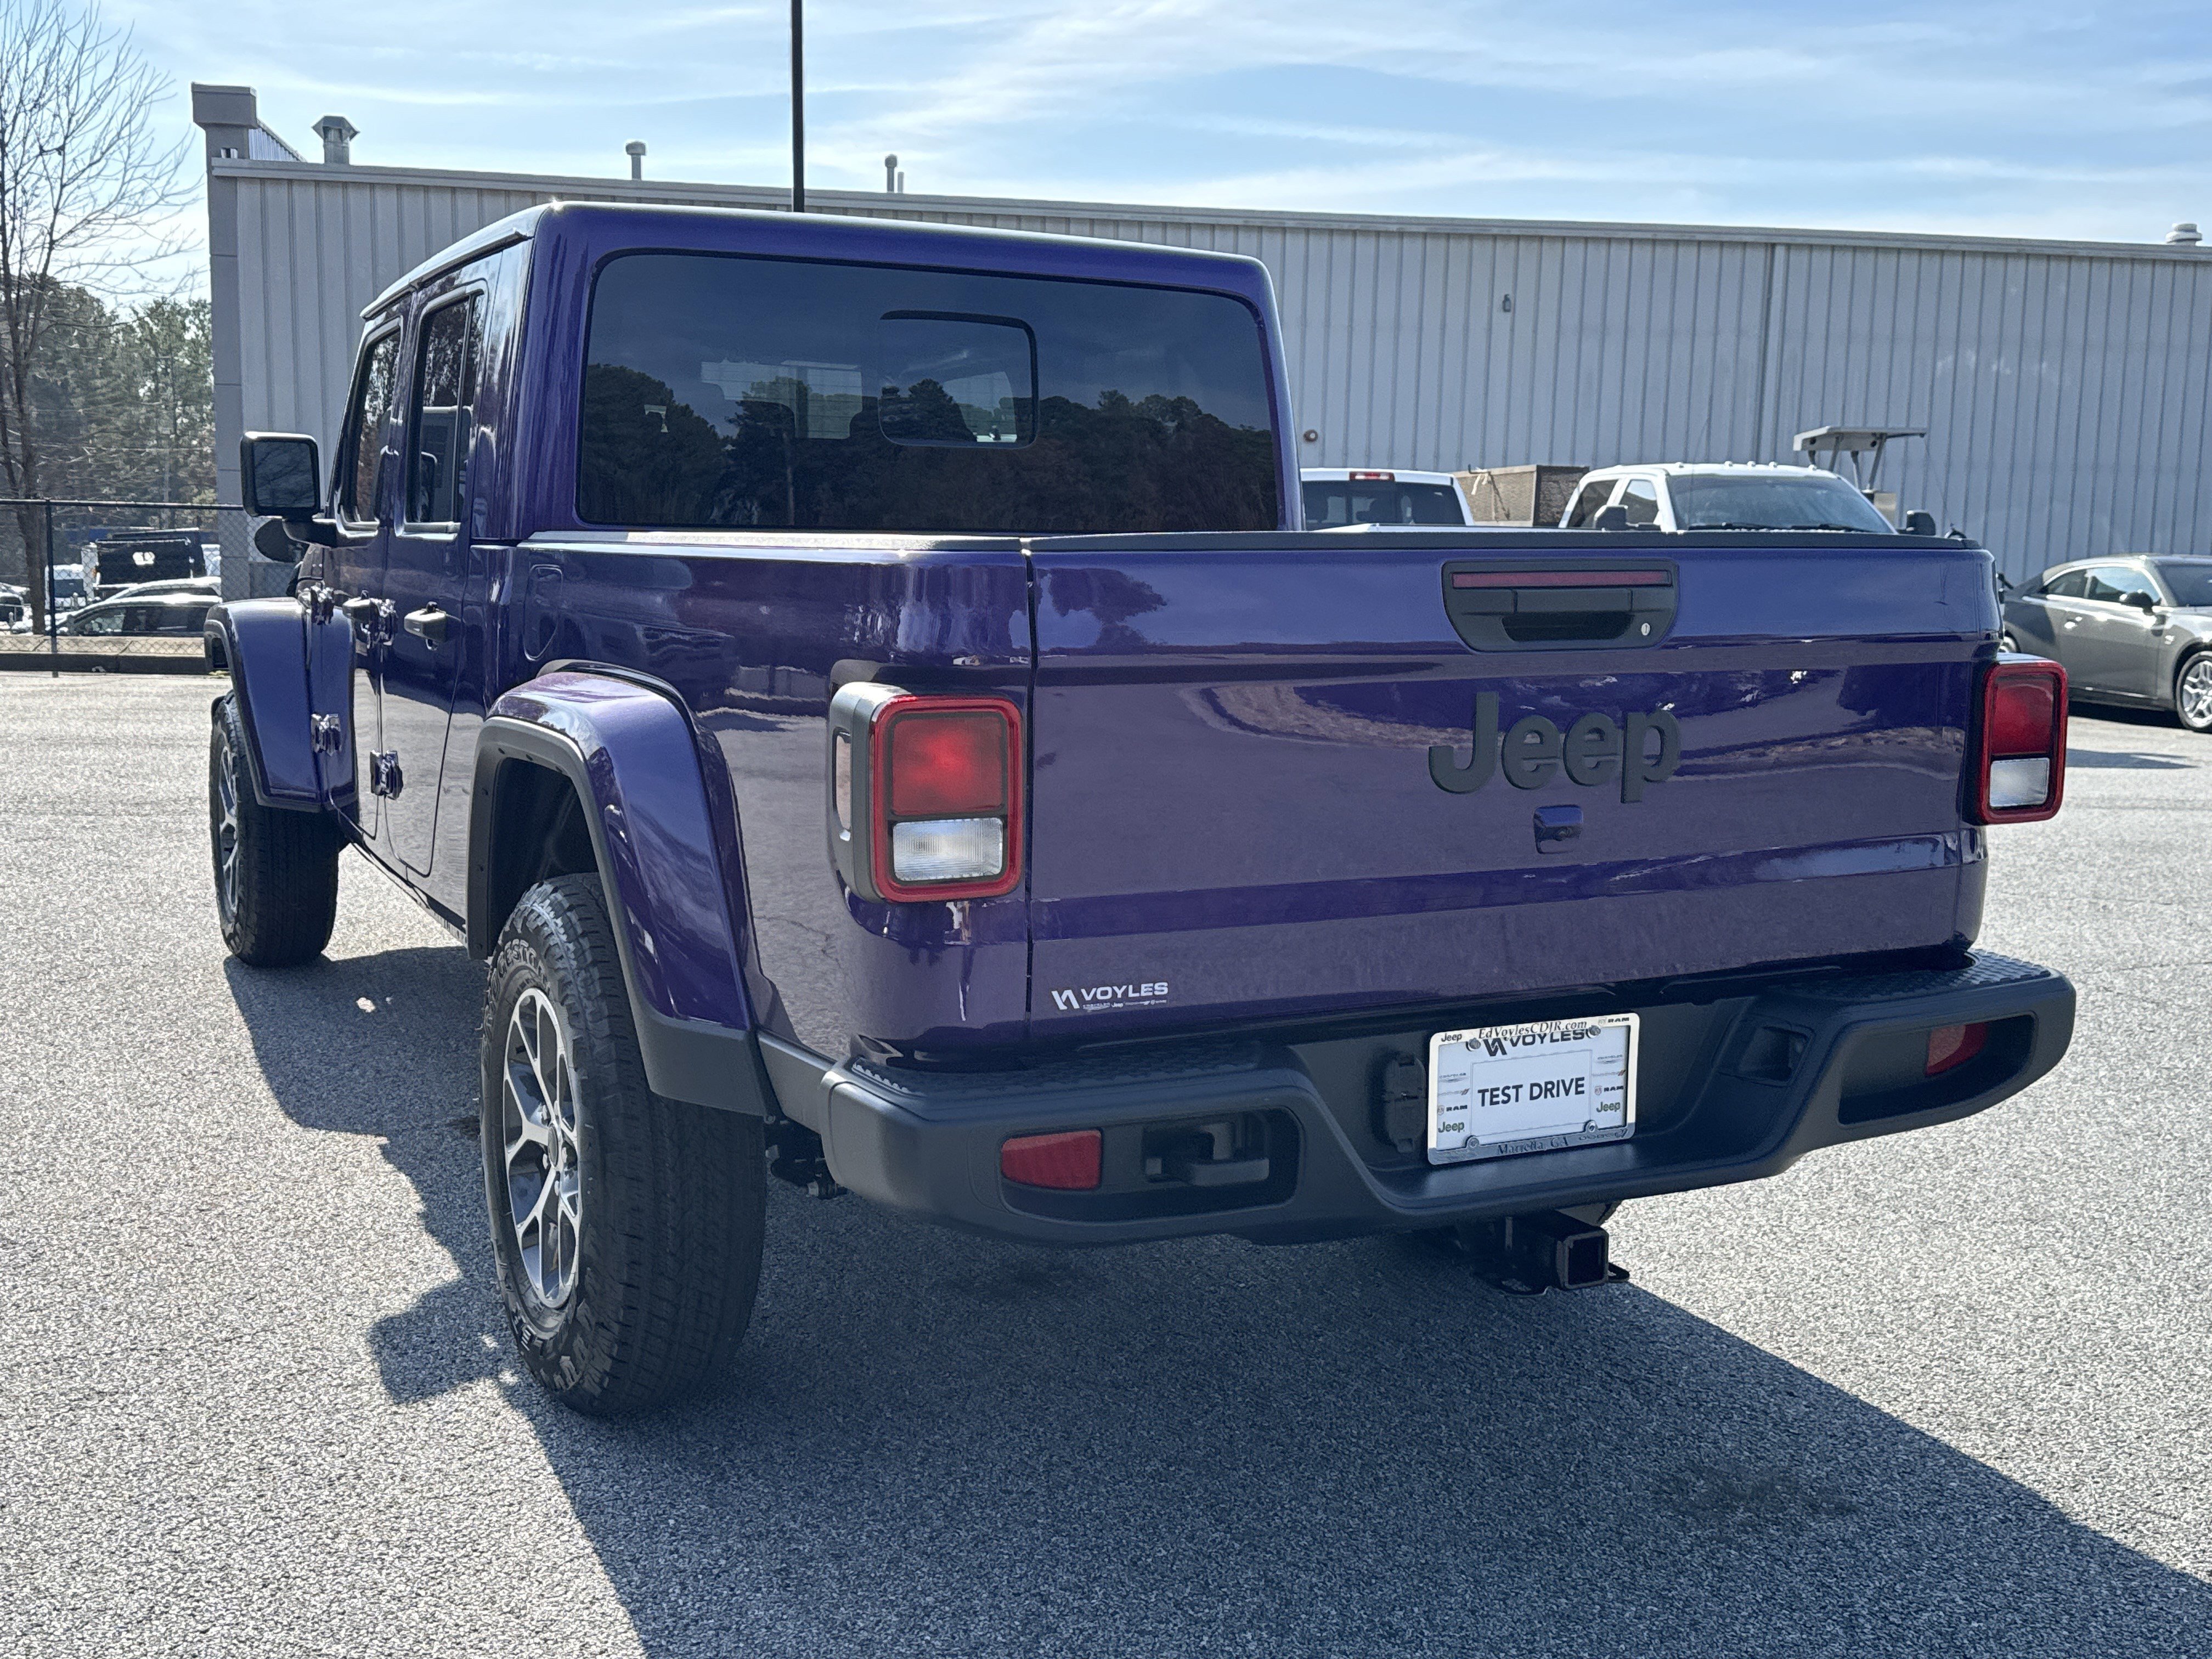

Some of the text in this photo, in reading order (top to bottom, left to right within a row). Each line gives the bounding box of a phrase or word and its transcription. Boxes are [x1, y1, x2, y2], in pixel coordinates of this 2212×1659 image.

[1429, 691, 1681, 803] Jeep
[1080, 982, 1169, 1001] VOYLES
[1441, 1032, 1463, 1042] Jeep
[1479, 1020, 1587, 1040] EdVoylesCDJR.com
[1509, 1029, 1585, 1047] VOYLES
[1477, 1076, 1585, 1107] TEST DRIVE
[1596, 1101, 1621, 1113] Jeep
[1438, 1121, 1465, 1133] Jeep
